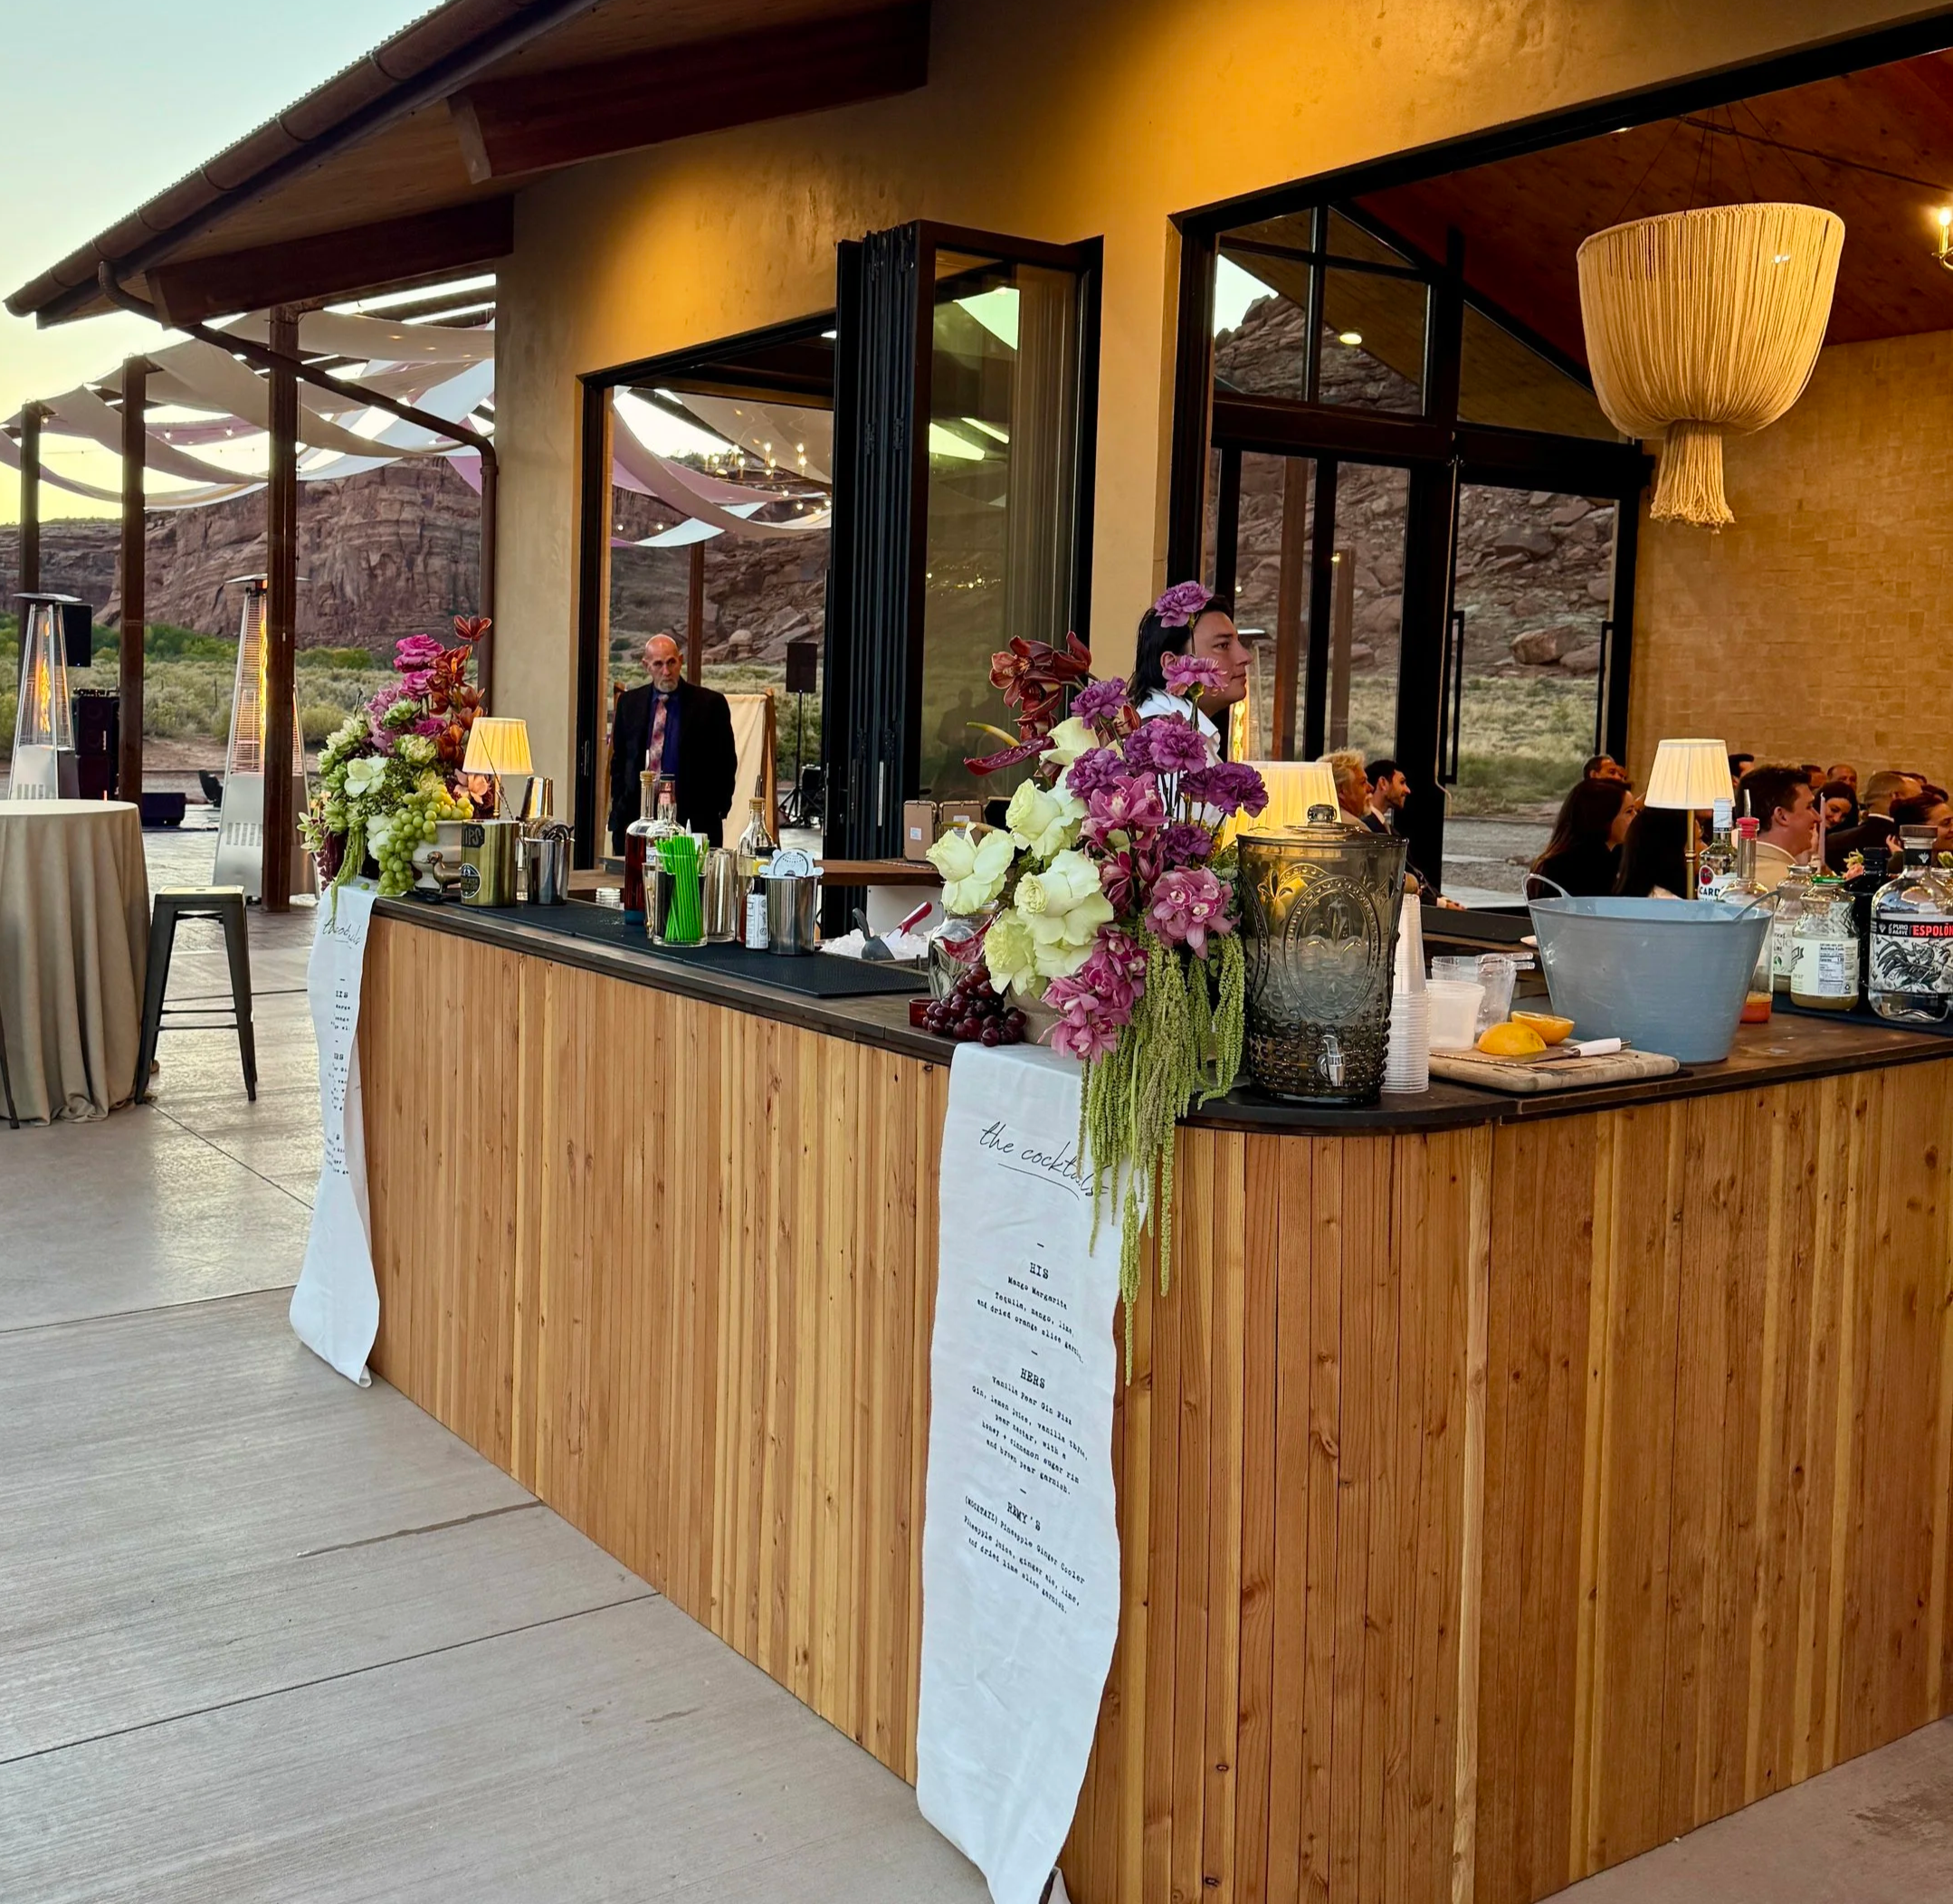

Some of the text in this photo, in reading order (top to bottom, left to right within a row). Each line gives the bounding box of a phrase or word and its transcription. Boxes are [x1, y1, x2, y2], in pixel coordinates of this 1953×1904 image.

[979, 1121, 1111, 1196] the cocktals
[1007, 1276, 1067, 1310] Mango Margarita
[1029, 1261, 1049, 1280] HIS
[976, 1299, 987, 1309] and
[990, 1305, 1011, 1319] dried
[1015, 1316, 1038, 1332] orange
[1041, 1327, 1062, 1344] slice
[995, 1291, 1027, 1312] Tequila,
[1031, 1308, 1054, 1325] mango,
[991, 1376, 1072, 1426] Vanilla Pear Gin Fizz
[1020, 1367, 1045, 1389] HERS
[971, 1385, 987, 1400] Gin,
[990, 1395, 1009, 1412] lemon
[1012, 1407, 1032, 1426] juice,
[1037, 1422, 1066, 1443] vanilla
[995, 1414, 1010, 1427] pear
[1012, 1423, 1037, 1445] nectar,
[1043, 1440, 1059, 1455] with
[982, 1420, 1000, 1438] honey
[1010, 1437, 1040, 1461] cinnamon
[1043, 1458, 1063, 1474] sugar
[1066, 1471, 1080, 1484] rim
[986, 1439, 1071, 1495] and brown pear garnish.
[1006, 1501, 1042, 1532] REMY'S
[964, 1515, 993, 1541] Pineapple
[996, 1539, 1015, 1560] juice,
[1019, 1557, 1043, 1576] ginger
[1061, 1585, 1080, 1606] lime,
[968, 1537, 978, 1549] and
[980, 1546, 999, 1564] dried
[1003, 1559, 1018, 1575] lime
[1022, 1573, 1039, 1590] slice
[1000, 1520, 1033, 1547] Pineapple
[1036, 1545, 1058, 1566] Ginger
[1061, 1562, 1085, 1585] Cooler
